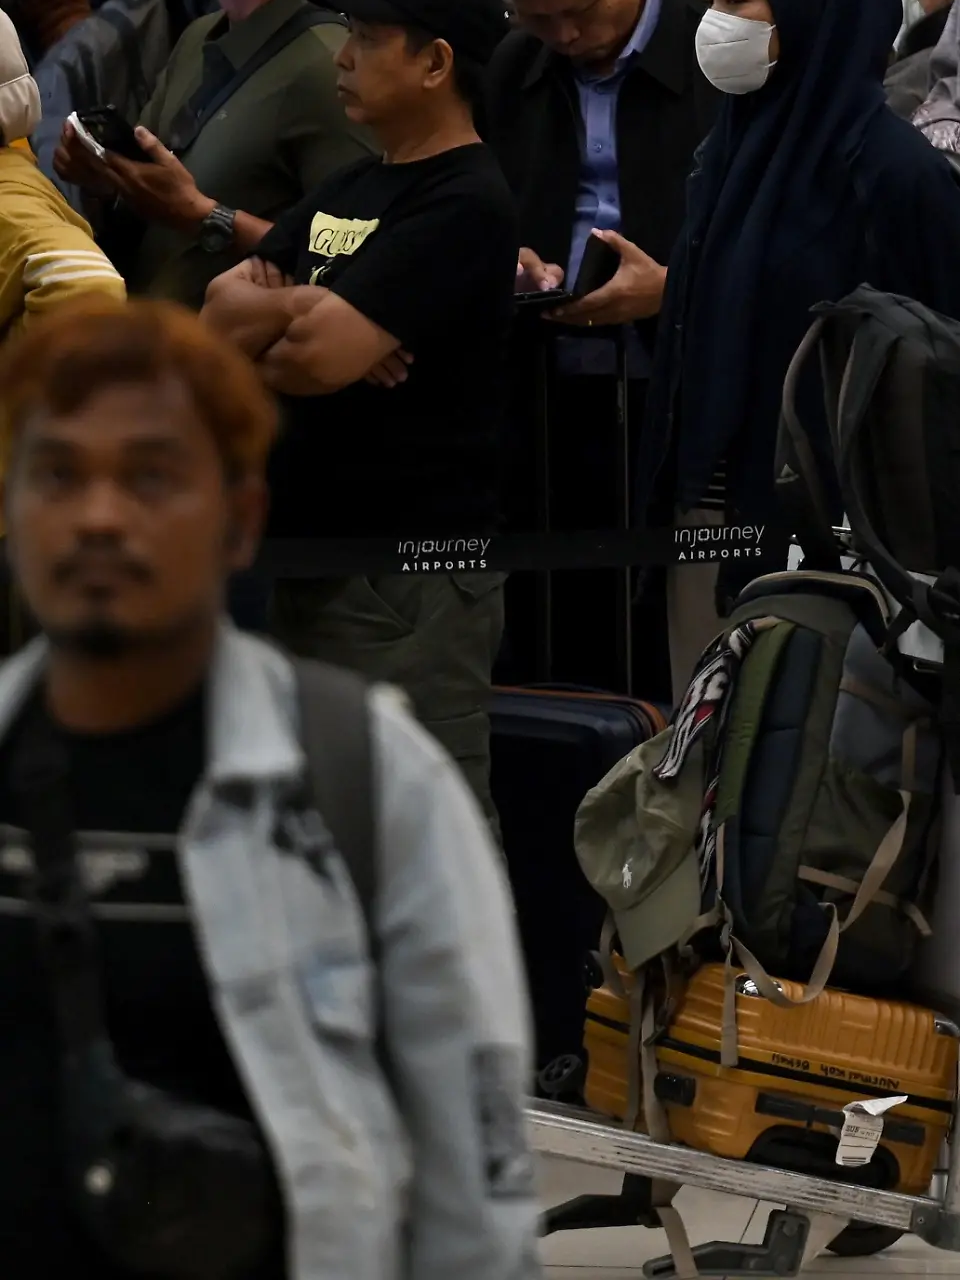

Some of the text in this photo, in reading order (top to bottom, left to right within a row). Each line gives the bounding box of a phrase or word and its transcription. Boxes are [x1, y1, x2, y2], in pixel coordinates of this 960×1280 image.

[674, 525, 765, 548] injourney
[397, 538, 491, 559] injourney
[678, 547, 762, 561] AIRPORTS
[402, 559, 487, 571] AIRPORTS
